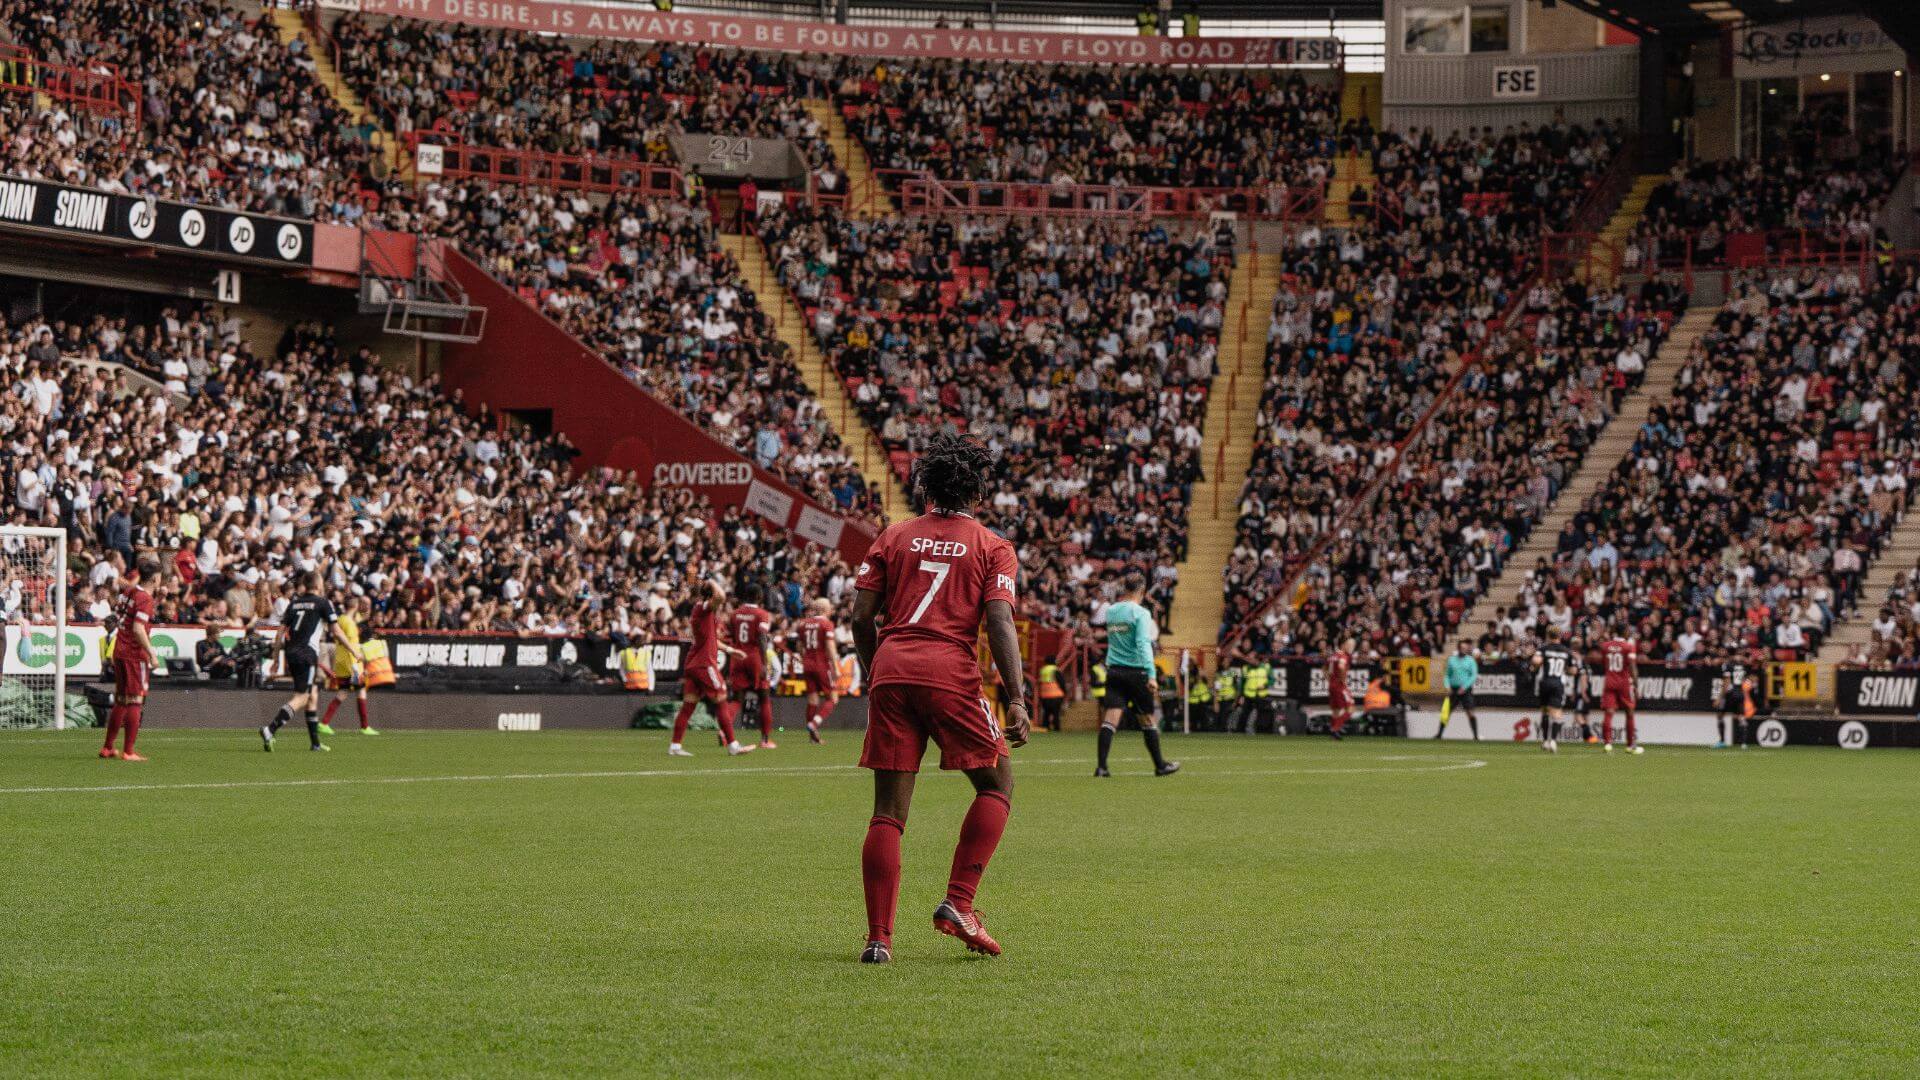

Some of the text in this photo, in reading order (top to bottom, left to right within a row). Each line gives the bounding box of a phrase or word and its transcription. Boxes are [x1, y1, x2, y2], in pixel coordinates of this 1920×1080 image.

[444, 0, 539, 26] DESIRE,
[552, 9, 576, 27] IS
[587, 12, 694, 36] ALWAYS
[708, 21, 742, 39] TO
[755, 25, 786, 42] BE
[797, 27, 890, 49] FOUND
[903, 33, 937, 50] AT
[951, 36, 1049, 55] VALLEY
[1061, 39, 1146, 57] FLOYD
[1159, 41, 1235, 58] ROAD
[1295, 38, 1336, 61] FSB
[1497, 70, 1536, 92] FSE
[708, 135, 752, 163] 24
[0, 181, 37, 222] DMN
[54, 189, 109, 232] SDMN
[184, 220, 201, 236] JD
[233, 226, 250, 243] JD
[281, 234, 298, 250] JD
[225, 273, 234, 299] A
[653, 462, 753, 485] COVERED
[910, 537, 967, 557] SPEED
[908, 560, 951, 624] 7
[294, 610, 306, 631] 7
[739, 622, 749, 643] 6
[804, 629, 818, 649] 14
[1548, 658, 1566, 678] 10
[1607, 653, 1623, 673] 10
[1405, 666, 1427, 685] 10
[1791, 671, 1811, 692] 11
[1858, 676, 1918, 707] SDMN
[1761, 728, 1782, 742] JD
[1842, 729, 1864, 743] JD
